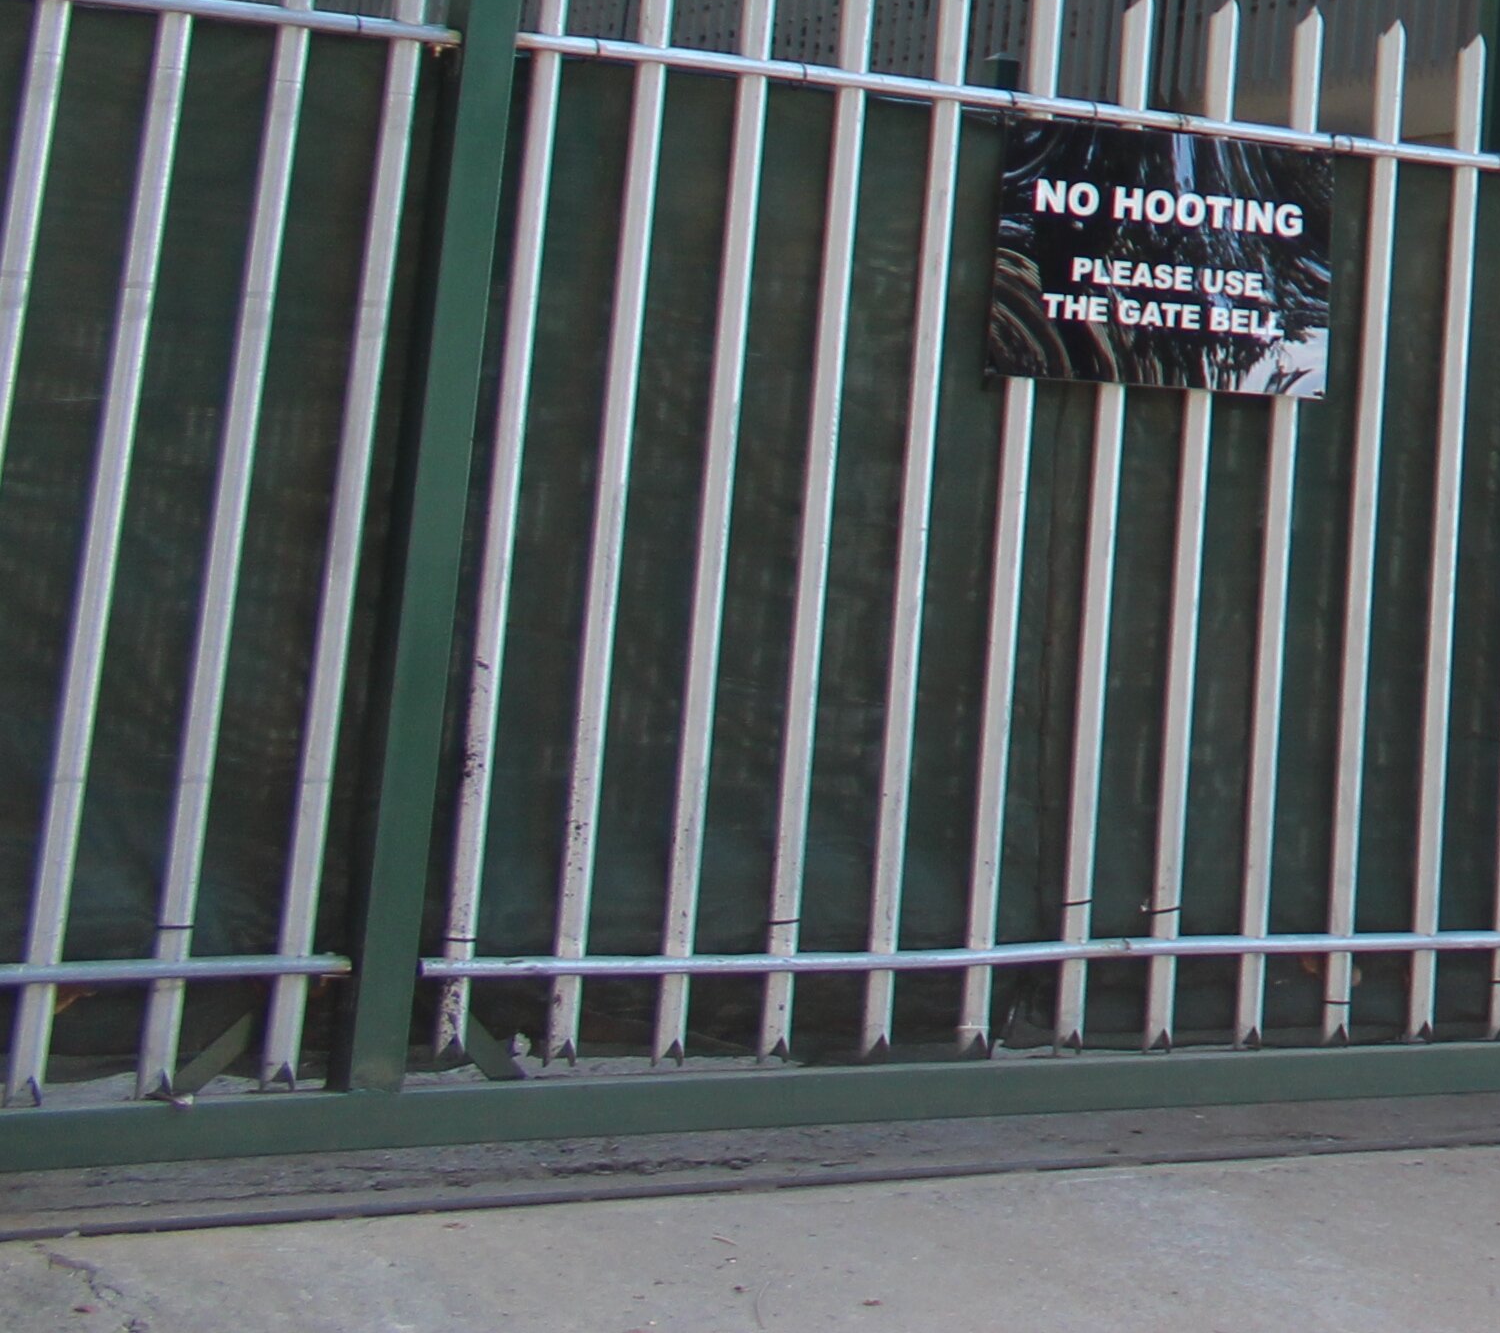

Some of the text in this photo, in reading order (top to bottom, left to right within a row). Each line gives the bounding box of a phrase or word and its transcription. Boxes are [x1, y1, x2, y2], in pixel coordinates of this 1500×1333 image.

[1034, 179, 1304, 238] NO HOOTING
[1072, 257, 1265, 298] PLEASE USE
[1042, 293, 1285, 337] THE GATE BELL
